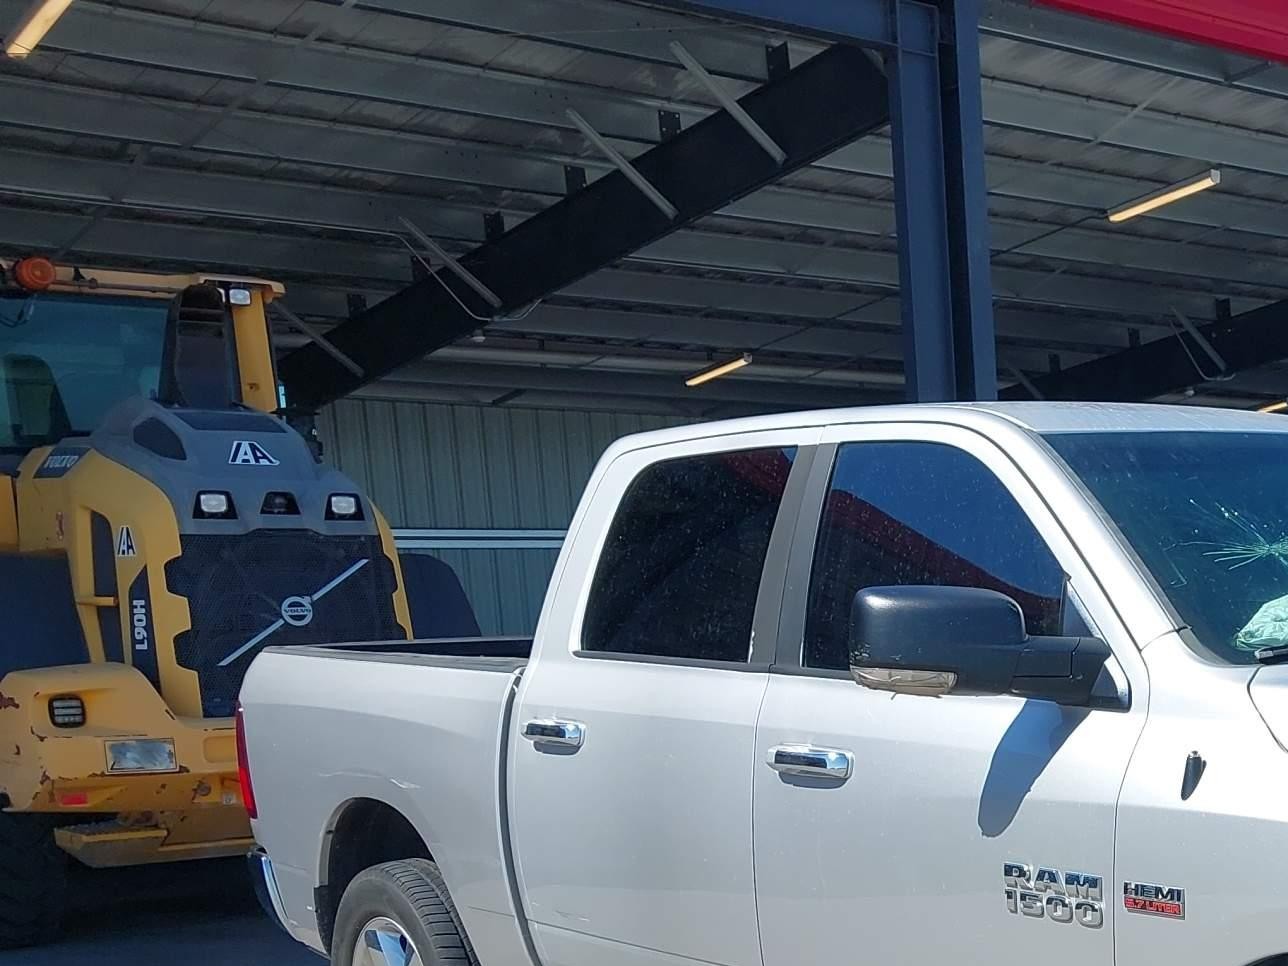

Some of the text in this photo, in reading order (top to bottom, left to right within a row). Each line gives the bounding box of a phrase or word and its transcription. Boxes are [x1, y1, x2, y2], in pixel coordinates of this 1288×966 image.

[43, 455, 79, 468] VOLVO
[229, 440, 280, 466] IAA
[132, 600, 148, 650] L90H
[1003, 862, 1104, 901] RAM
[1123, 881, 1184, 902] HEMI
[1004, 888, 1104, 930] 1500
